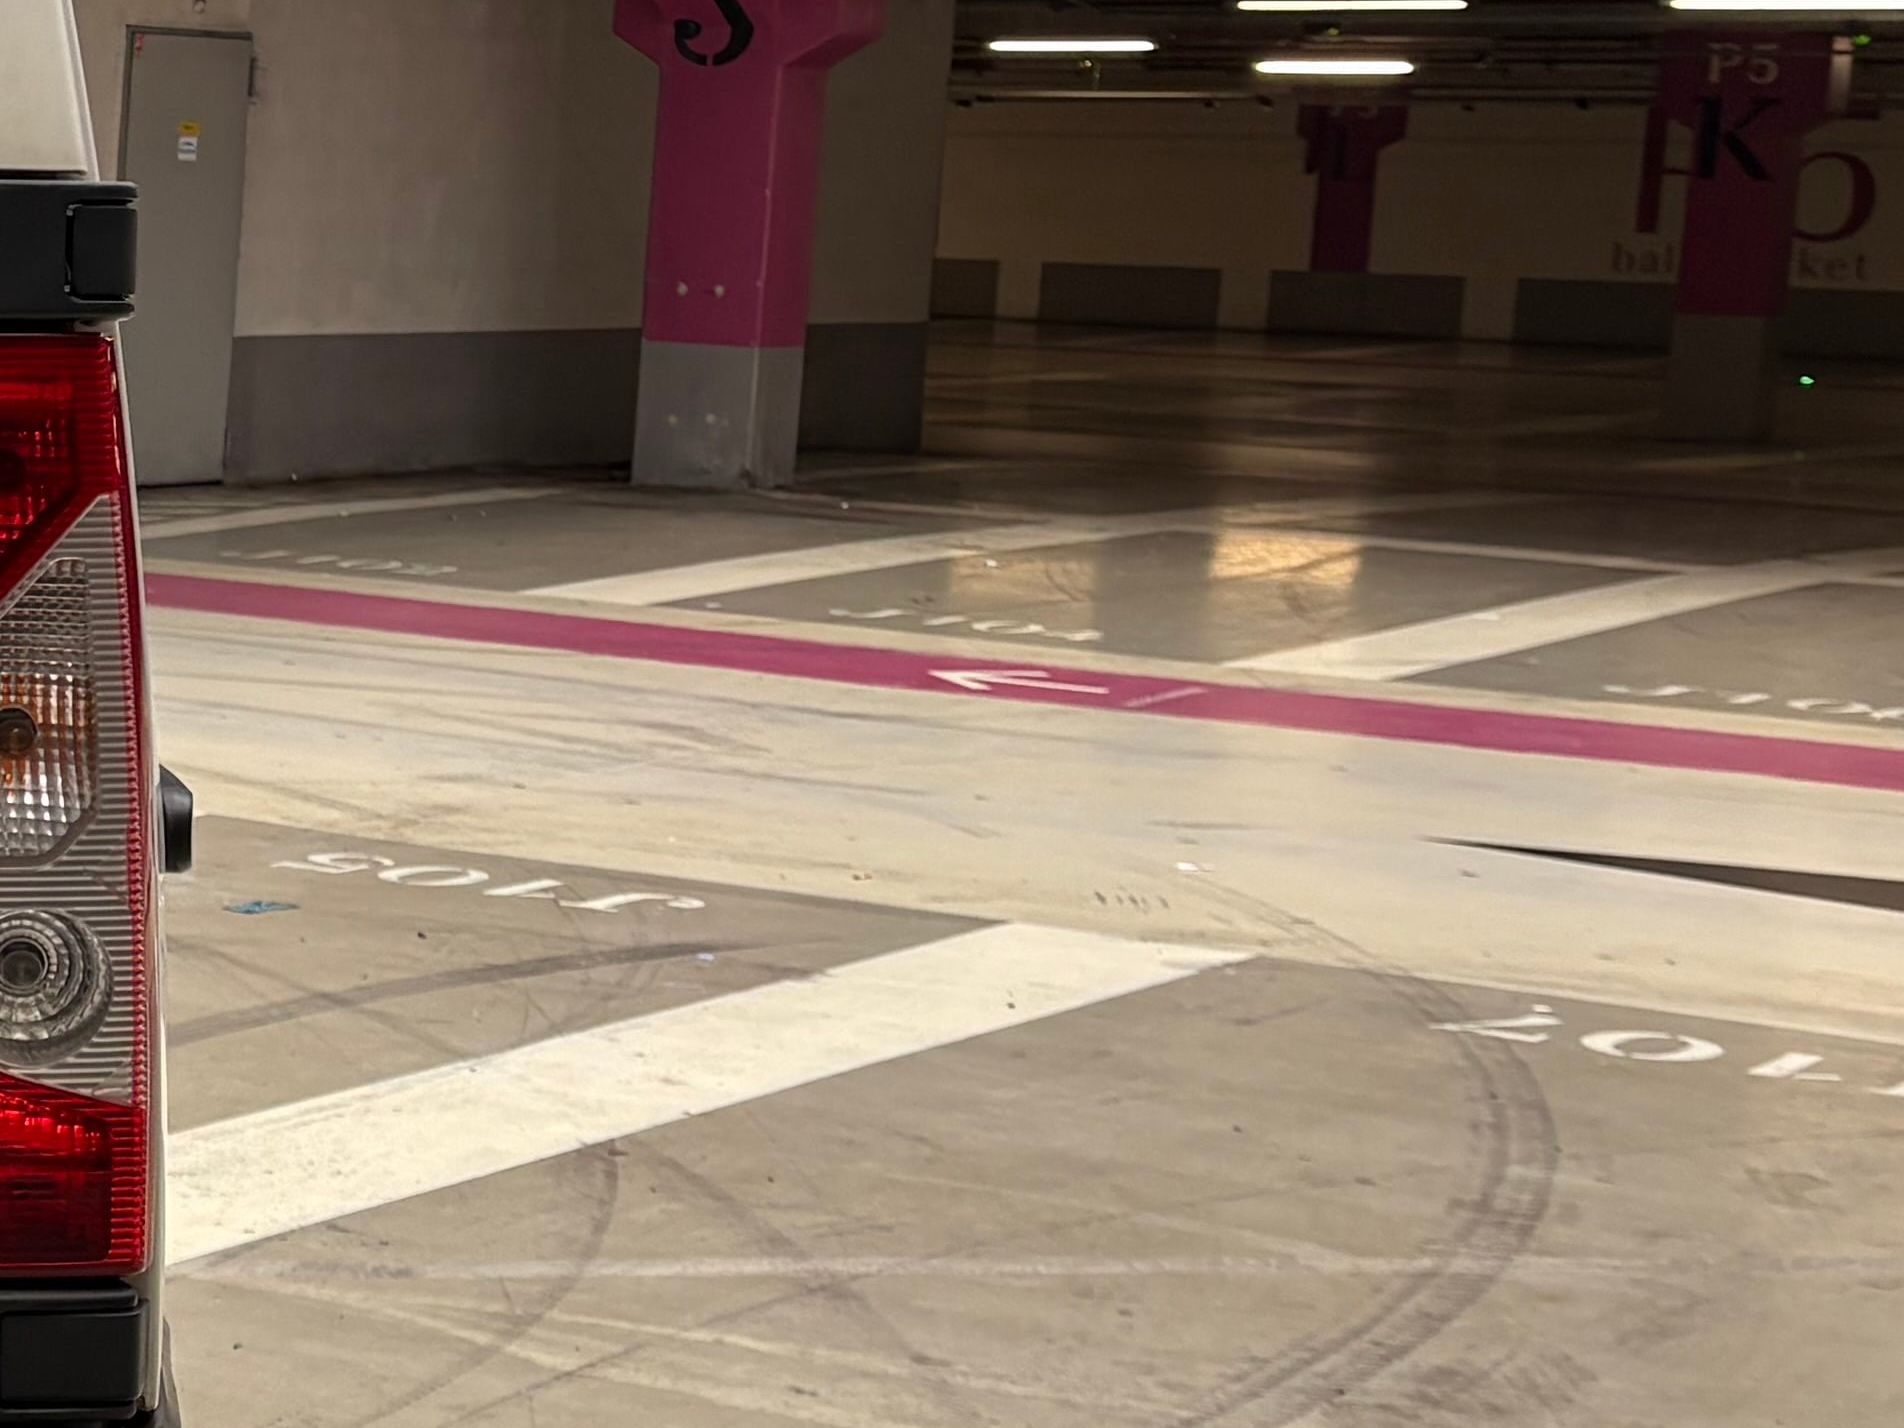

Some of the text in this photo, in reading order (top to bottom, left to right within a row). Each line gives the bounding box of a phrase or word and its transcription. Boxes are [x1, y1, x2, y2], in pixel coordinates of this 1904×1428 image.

[1706, 42, 1780, 84] P5
[1696, 97, 1781, 182] K
[270, 850, 706, 913] J105
